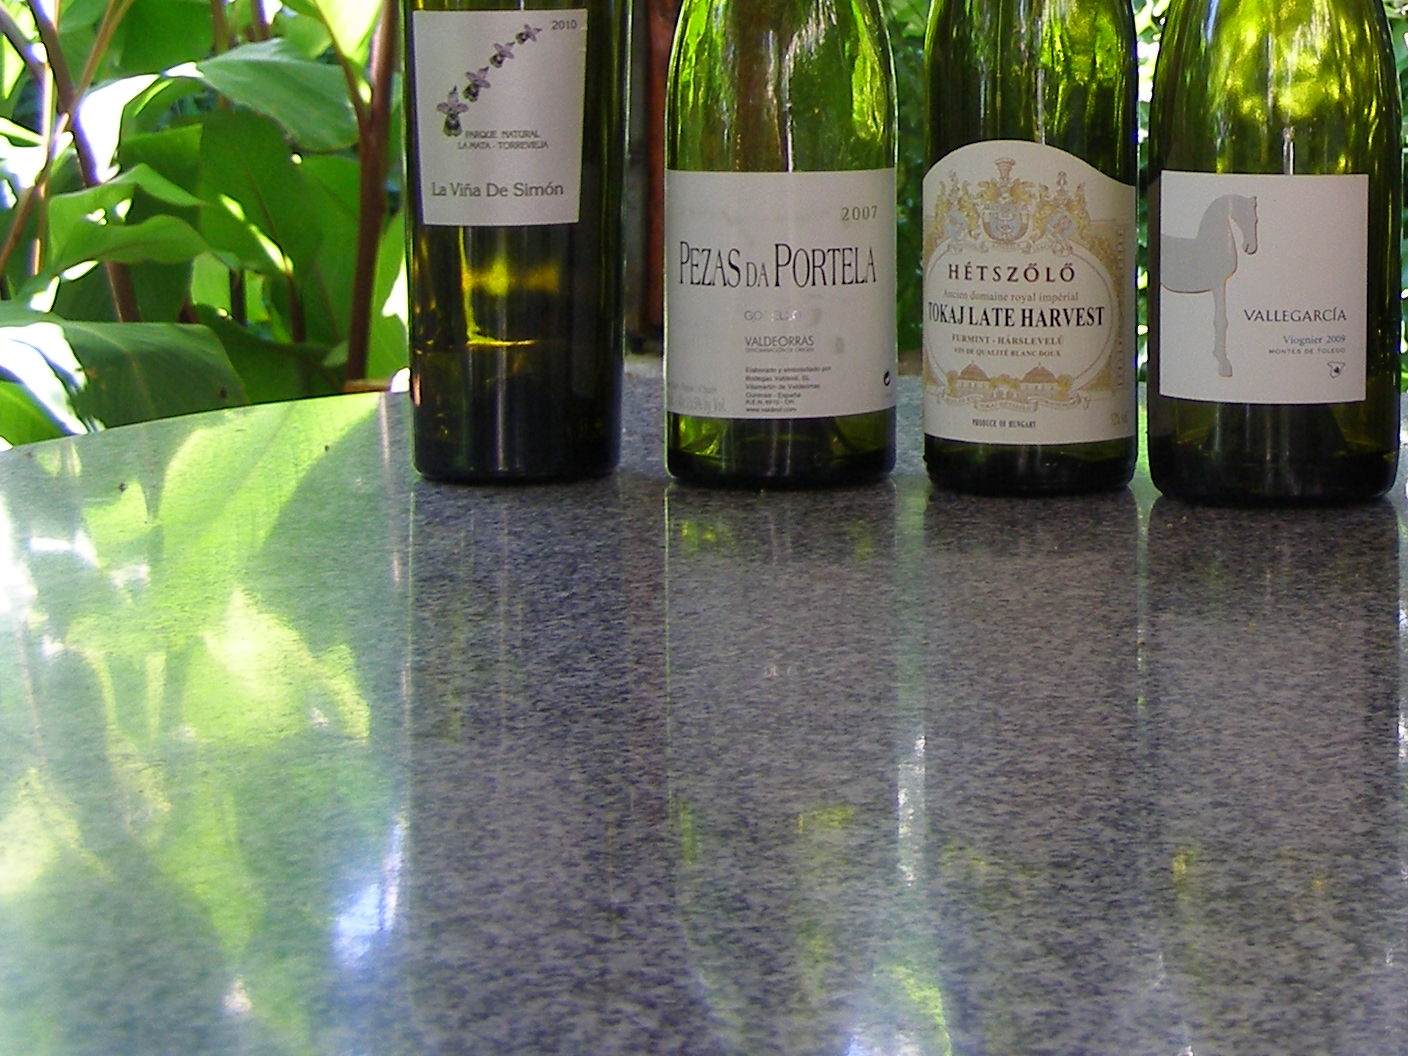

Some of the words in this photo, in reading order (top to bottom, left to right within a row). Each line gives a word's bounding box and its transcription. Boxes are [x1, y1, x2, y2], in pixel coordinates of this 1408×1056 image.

[552, 20, 577, 30] 2010
[431, 183, 447, 196] La
[450, 182, 481, 196] Viña
[486, 183, 509, 197] De
[513, 181, 564, 197] Simón
[841, 205, 878, 221] 2007
[679, 241, 742, 288] PEZAS
[746, 262, 769, 287] DA
[774, 243, 877, 288] PORTELA
[928, 301, 965, 325] TOKAJ
[969, 306, 1015, 327] LATE
[1021, 306, 1105, 328] HARVEST
[1244, 307, 1347, 322] VALLEGARCÍA
[745, 335, 815, 347] VALDEORRAS
